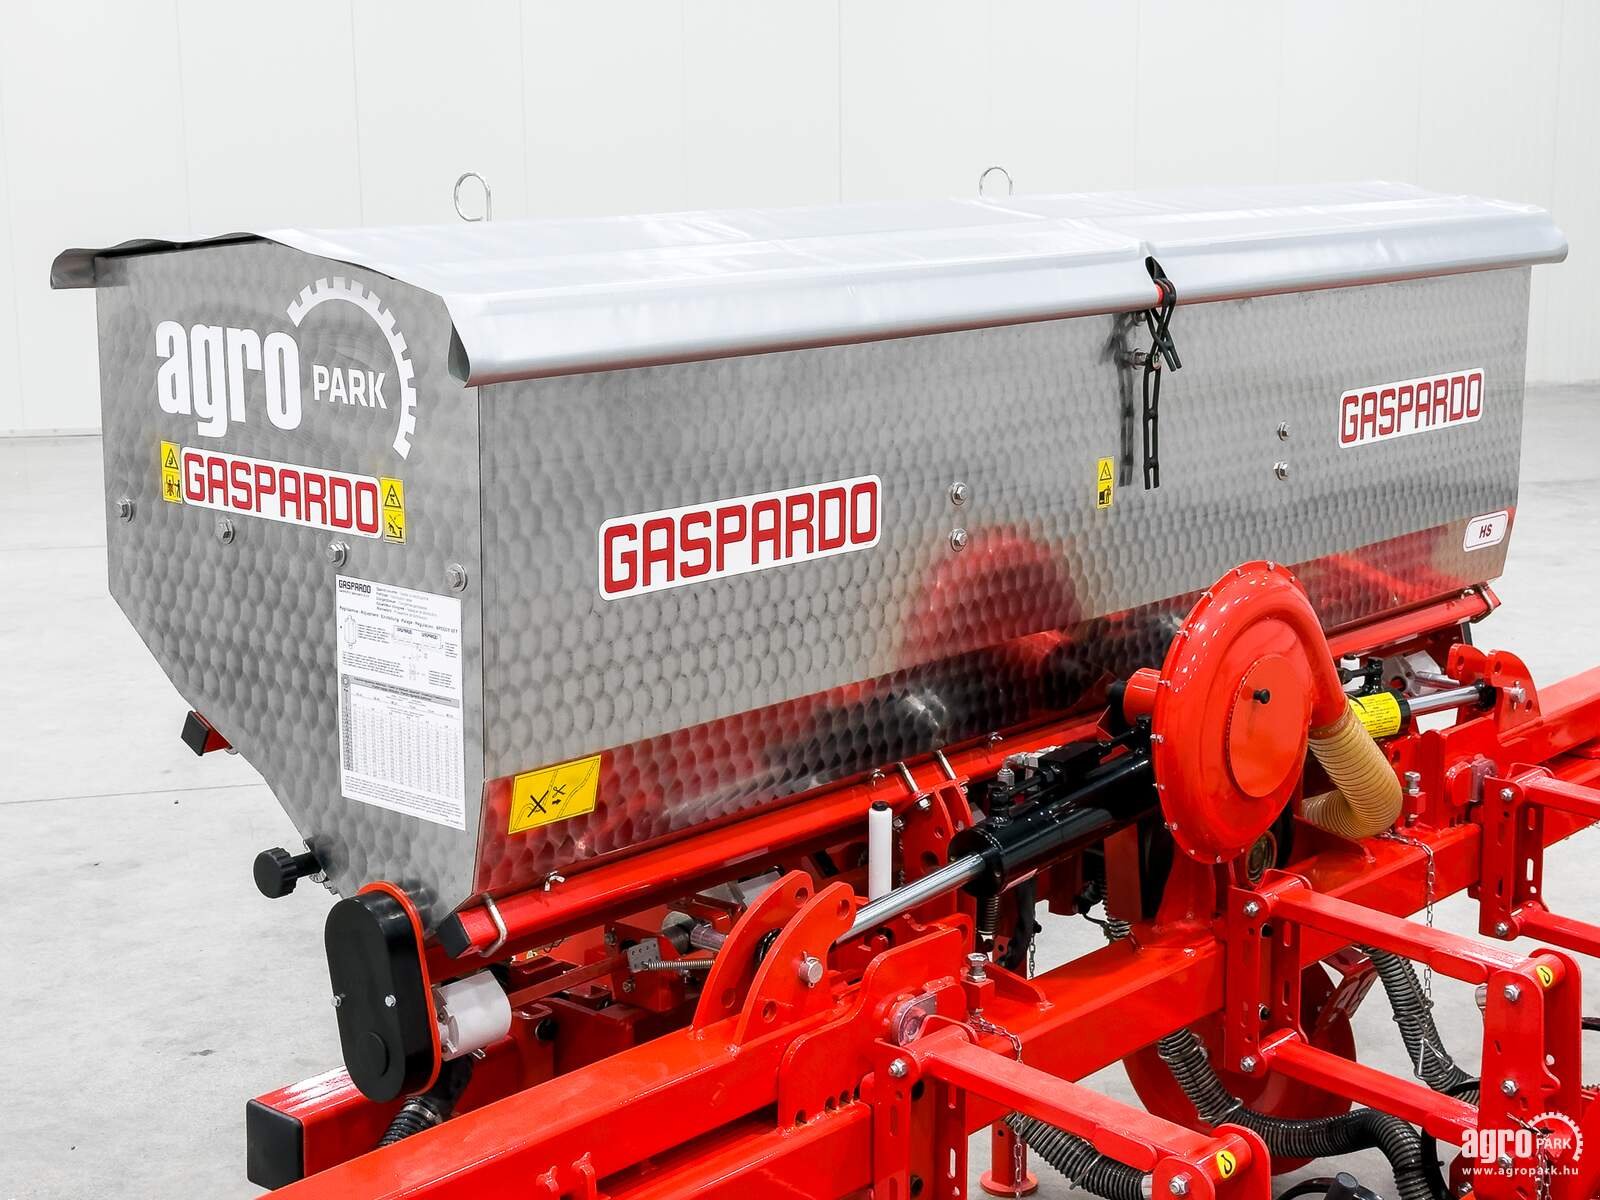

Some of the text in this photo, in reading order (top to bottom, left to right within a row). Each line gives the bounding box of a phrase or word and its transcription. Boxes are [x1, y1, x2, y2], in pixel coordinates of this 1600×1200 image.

[155, 320, 388, 438] agro PARK
[1341, 372, 1483, 444] GASPARDO
[183, 452, 379, 534] GASPARDO
[1479, 523, 1493, 539] HS
[603, 481, 878, 594] GASPARDO
[338, 579, 372, 594] GASPARDO
